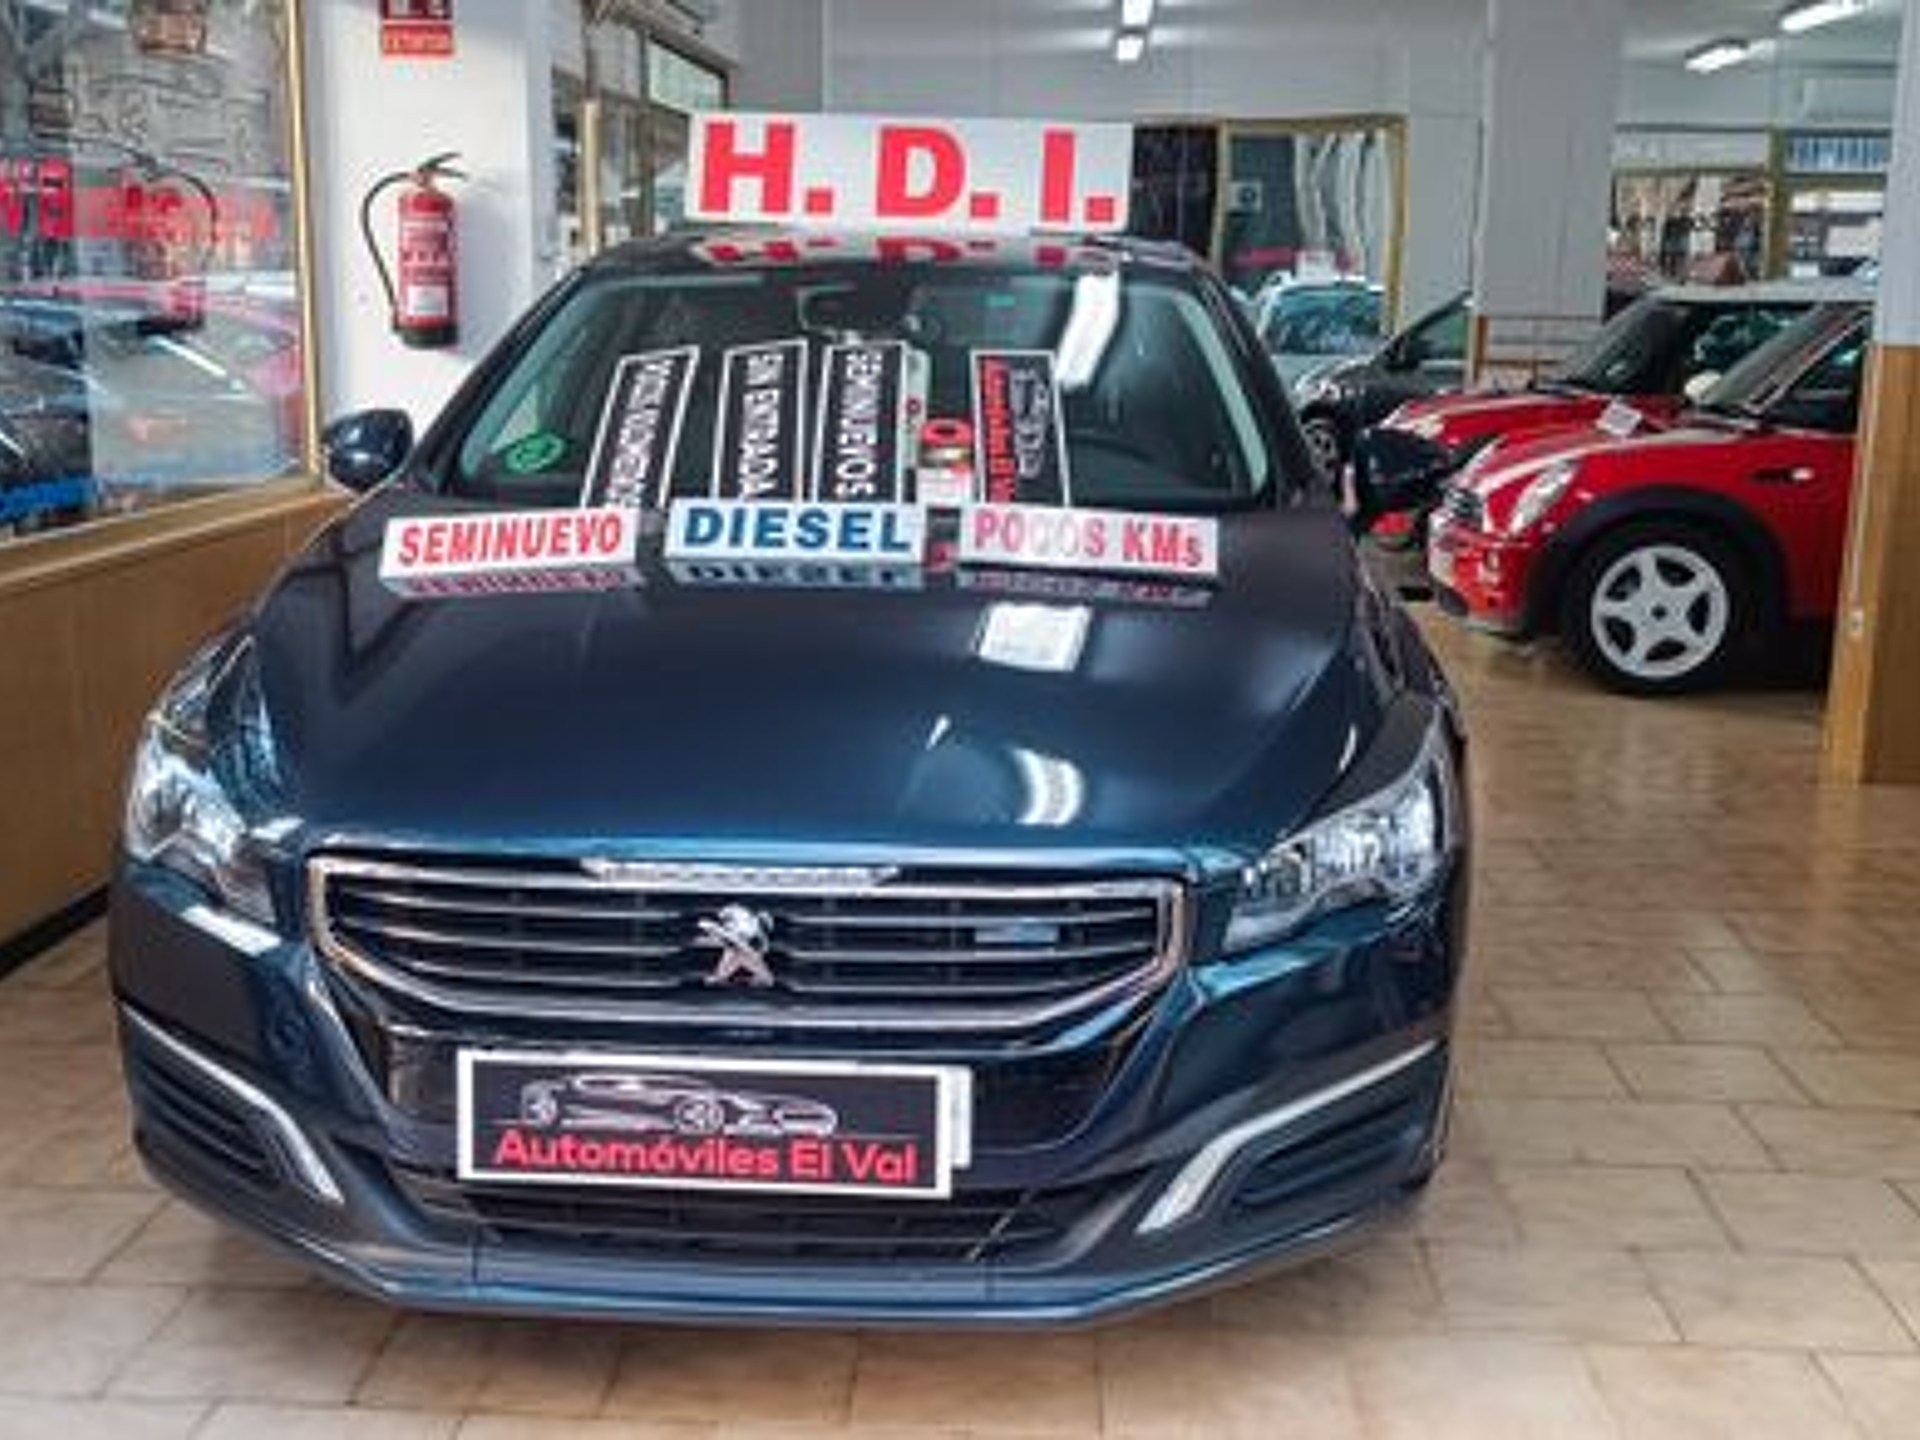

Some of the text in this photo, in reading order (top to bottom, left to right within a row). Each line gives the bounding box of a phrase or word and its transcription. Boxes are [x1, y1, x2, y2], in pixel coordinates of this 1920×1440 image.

[736, 388, 780, 500] ENTRADA
[834, 353, 883, 497] SEMINUEVOS
[397, 512, 623, 567] SEMINUEVO
[684, 506, 911, 552] DIESEL
[1121, 517, 1203, 569] KMs
[495, 1128, 918, 1182] Automóviles El Val
